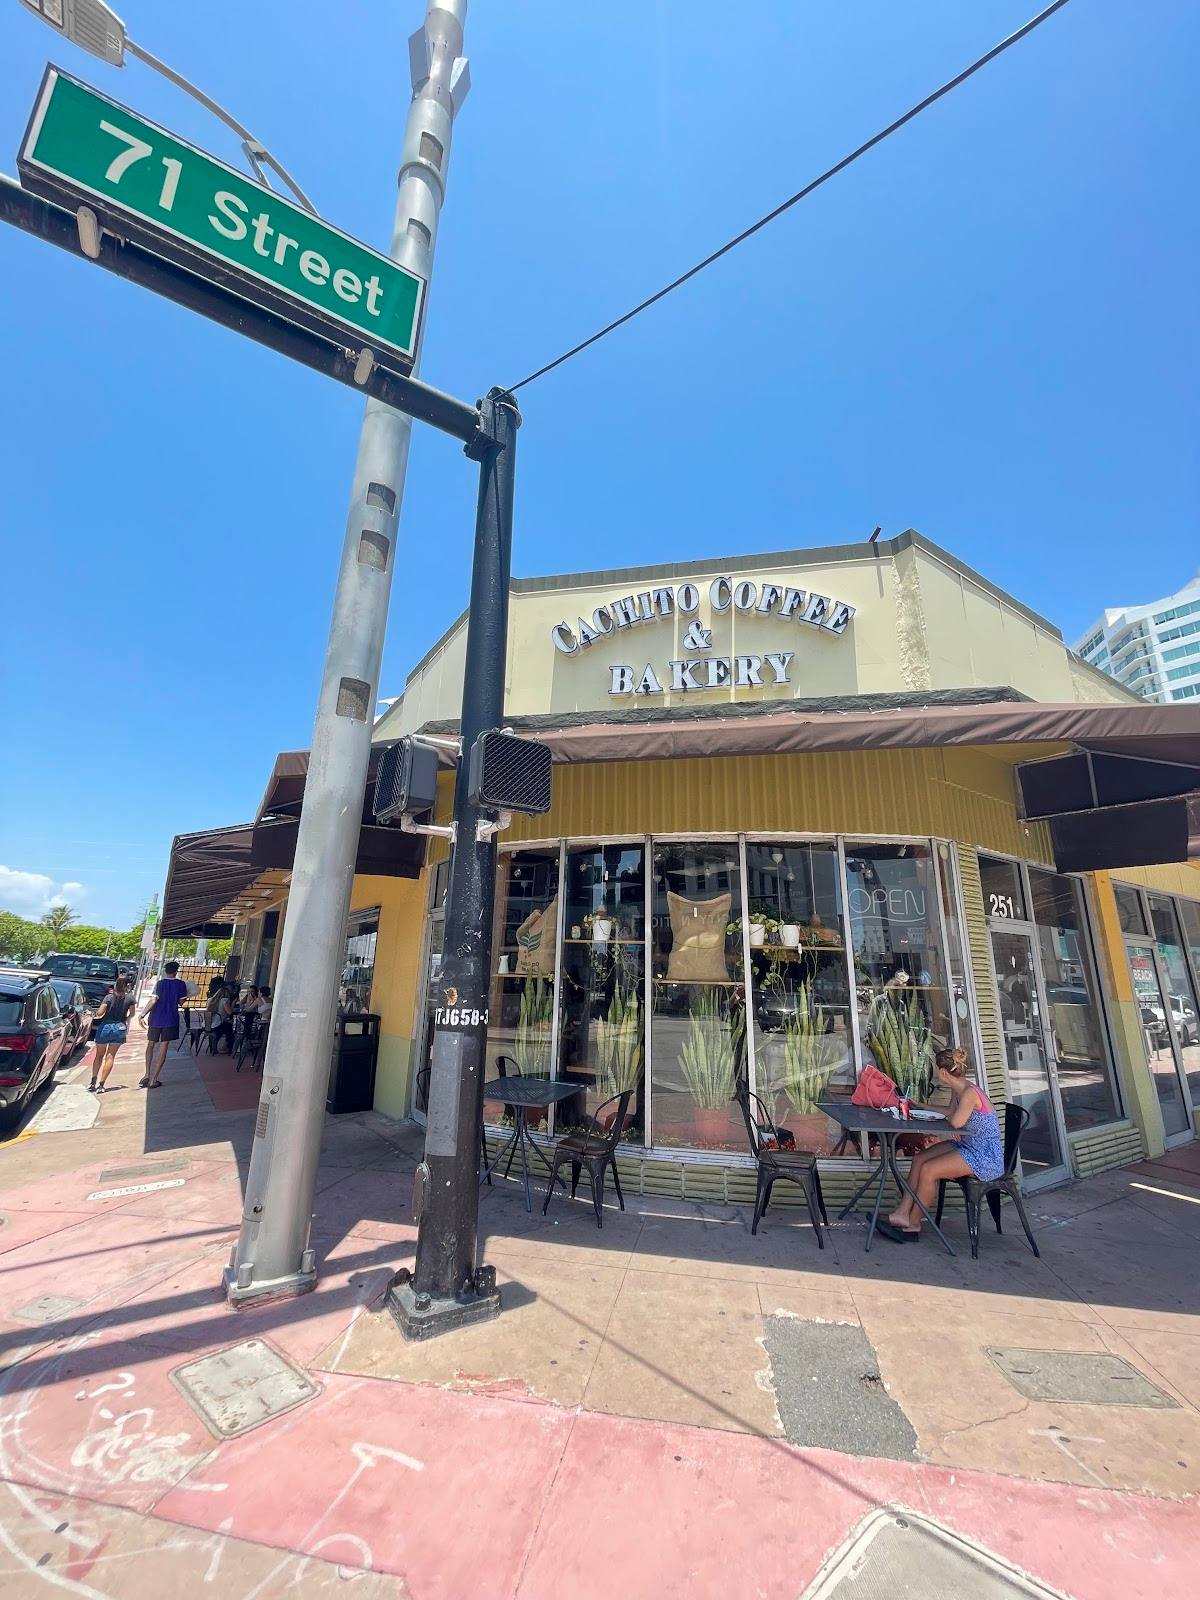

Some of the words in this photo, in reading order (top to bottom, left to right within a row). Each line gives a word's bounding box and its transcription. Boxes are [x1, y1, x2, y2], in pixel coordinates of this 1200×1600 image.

[98, 119, 185, 213] 71
[206, 189, 386, 318] Street
[551, 581, 700, 656] CACHITO
[708, 575, 857, 640] COFFEE
[683, 619, 713, 652] &
[607, 651, 796, 697] BAKERY
[848, 888, 926, 916] OPEN
[989, 893, 1015, 919] 251
